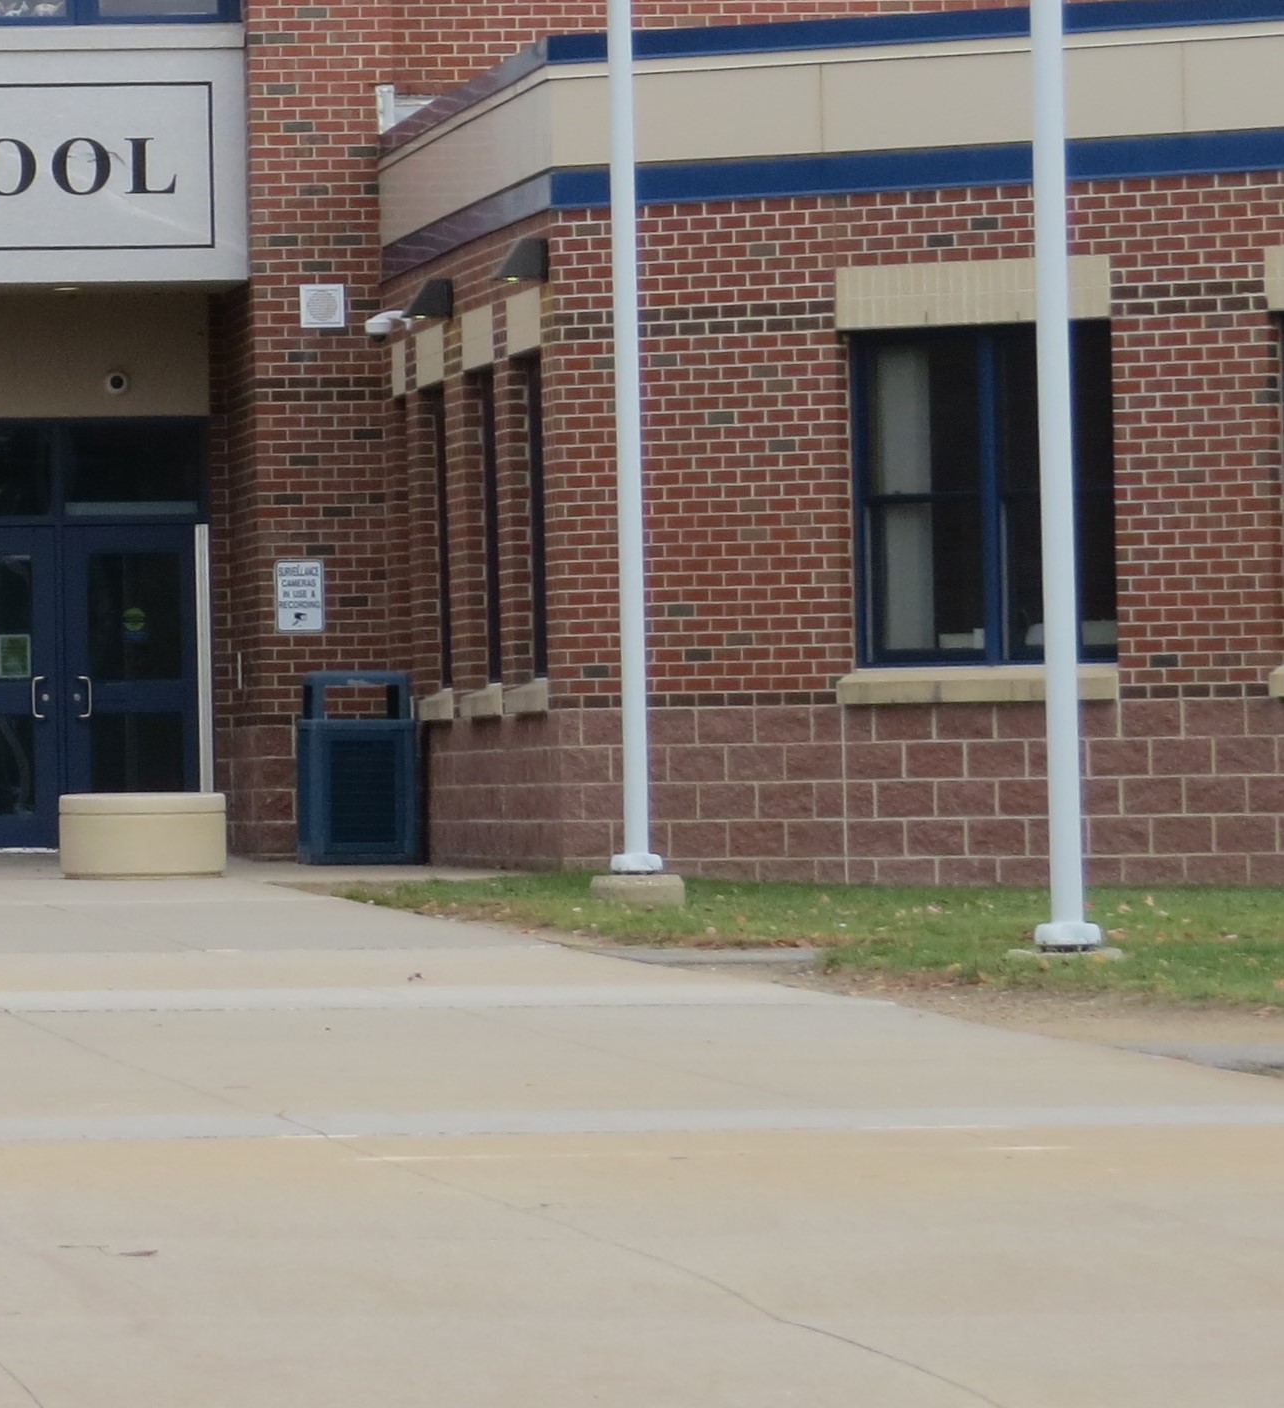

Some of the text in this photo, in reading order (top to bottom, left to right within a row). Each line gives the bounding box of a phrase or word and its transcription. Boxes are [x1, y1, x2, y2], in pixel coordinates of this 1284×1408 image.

[278, 566, 319, 577] SURVEILLANCE
[281, 578, 316, 588] CAMERAS
[292, 590, 307, 598] USE
[278, 600, 320, 609] RECORDING
